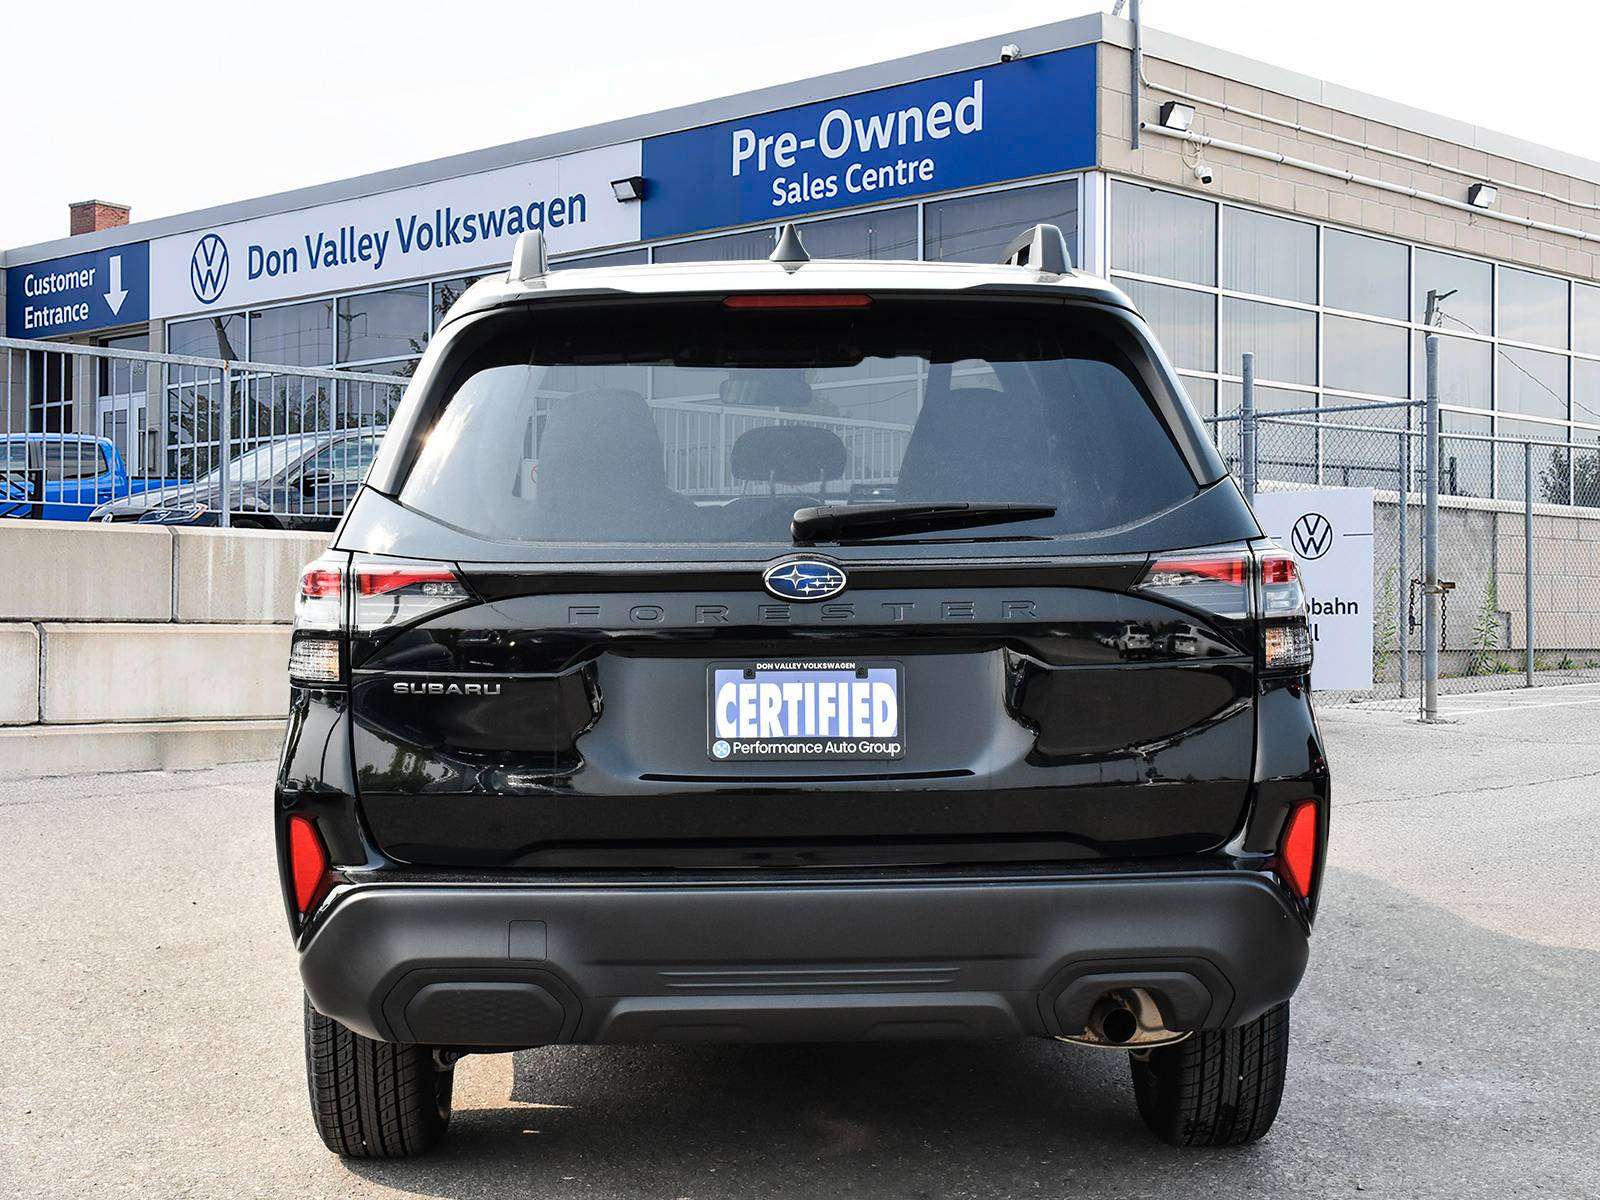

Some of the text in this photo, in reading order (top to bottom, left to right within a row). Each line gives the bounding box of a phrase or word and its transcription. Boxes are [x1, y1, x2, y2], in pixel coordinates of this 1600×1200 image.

[732, 79, 984, 177] Pre-Owned
[772, 158, 935, 207] Sales Centre
[248, 192, 587, 281] Don Valley Volkswagen
[24, 268, 96, 297] Customer
[24, 302, 89, 329] Entrance
[568, 601, 1041, 624] FORESTER
[774, 662, 802, 670] VALLEY
[802, 662, 856, 670] VOLKSWAGEN
[392, 682, 503, 696] SUBARU
[715, 682, 898, 738] CERTIFIED
[732, 740, 901, 757] Performance Auto Group
